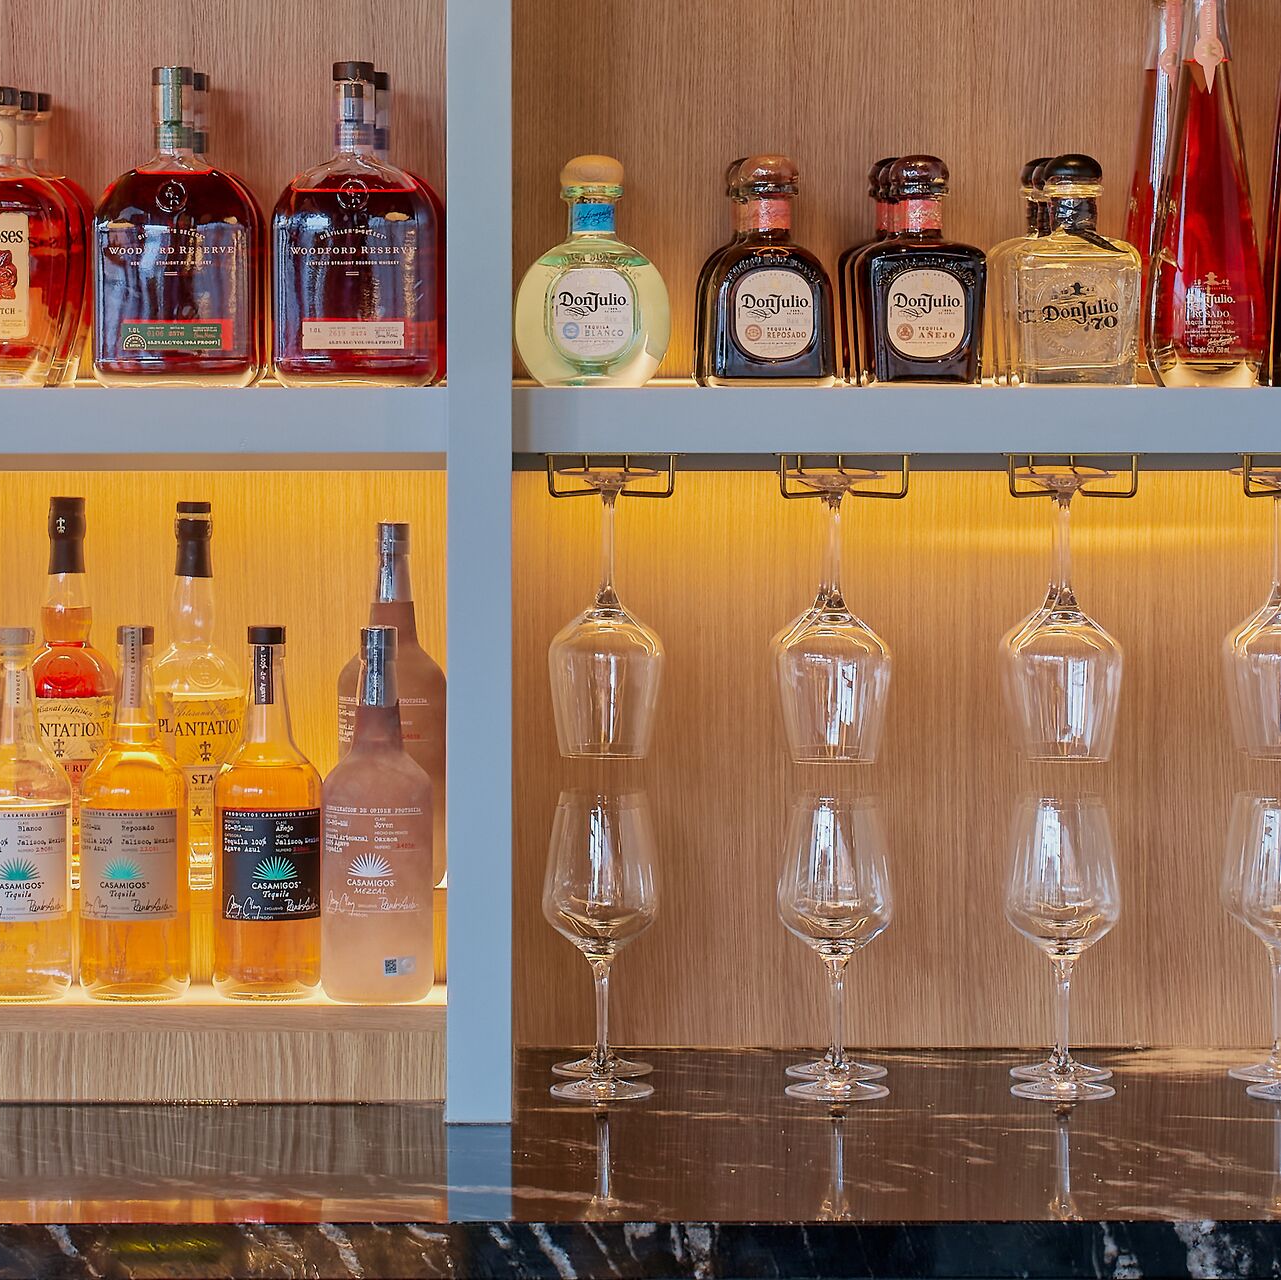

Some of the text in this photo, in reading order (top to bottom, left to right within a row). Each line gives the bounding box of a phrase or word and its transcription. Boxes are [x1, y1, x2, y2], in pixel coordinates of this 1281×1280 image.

[291, 245, 416, 255] WOODFORD RESERVE
[1192, 309, 1230, 318] ROSADO
[1092, 316, 1118, 330] 70
[585, 329, 624, 337] BLANCO
[767, 331, 807, 339] REPOSADO
[919, 330, 956, 339] AÑEJO
[18, 825, 42, 833] Blanco
[100, 881, 147, 889] CASAMIGOS
[252, 882, 299, 890] CASAMIGOS
[347, 878, 394, 887] CASAMIGOS
[5, 891, 32, 899] Tequila
[110, 890, 136, 898] Tequila
[262, 890, 289, 898] Tequila
[354, 887, 386, 895] MEZCAL
